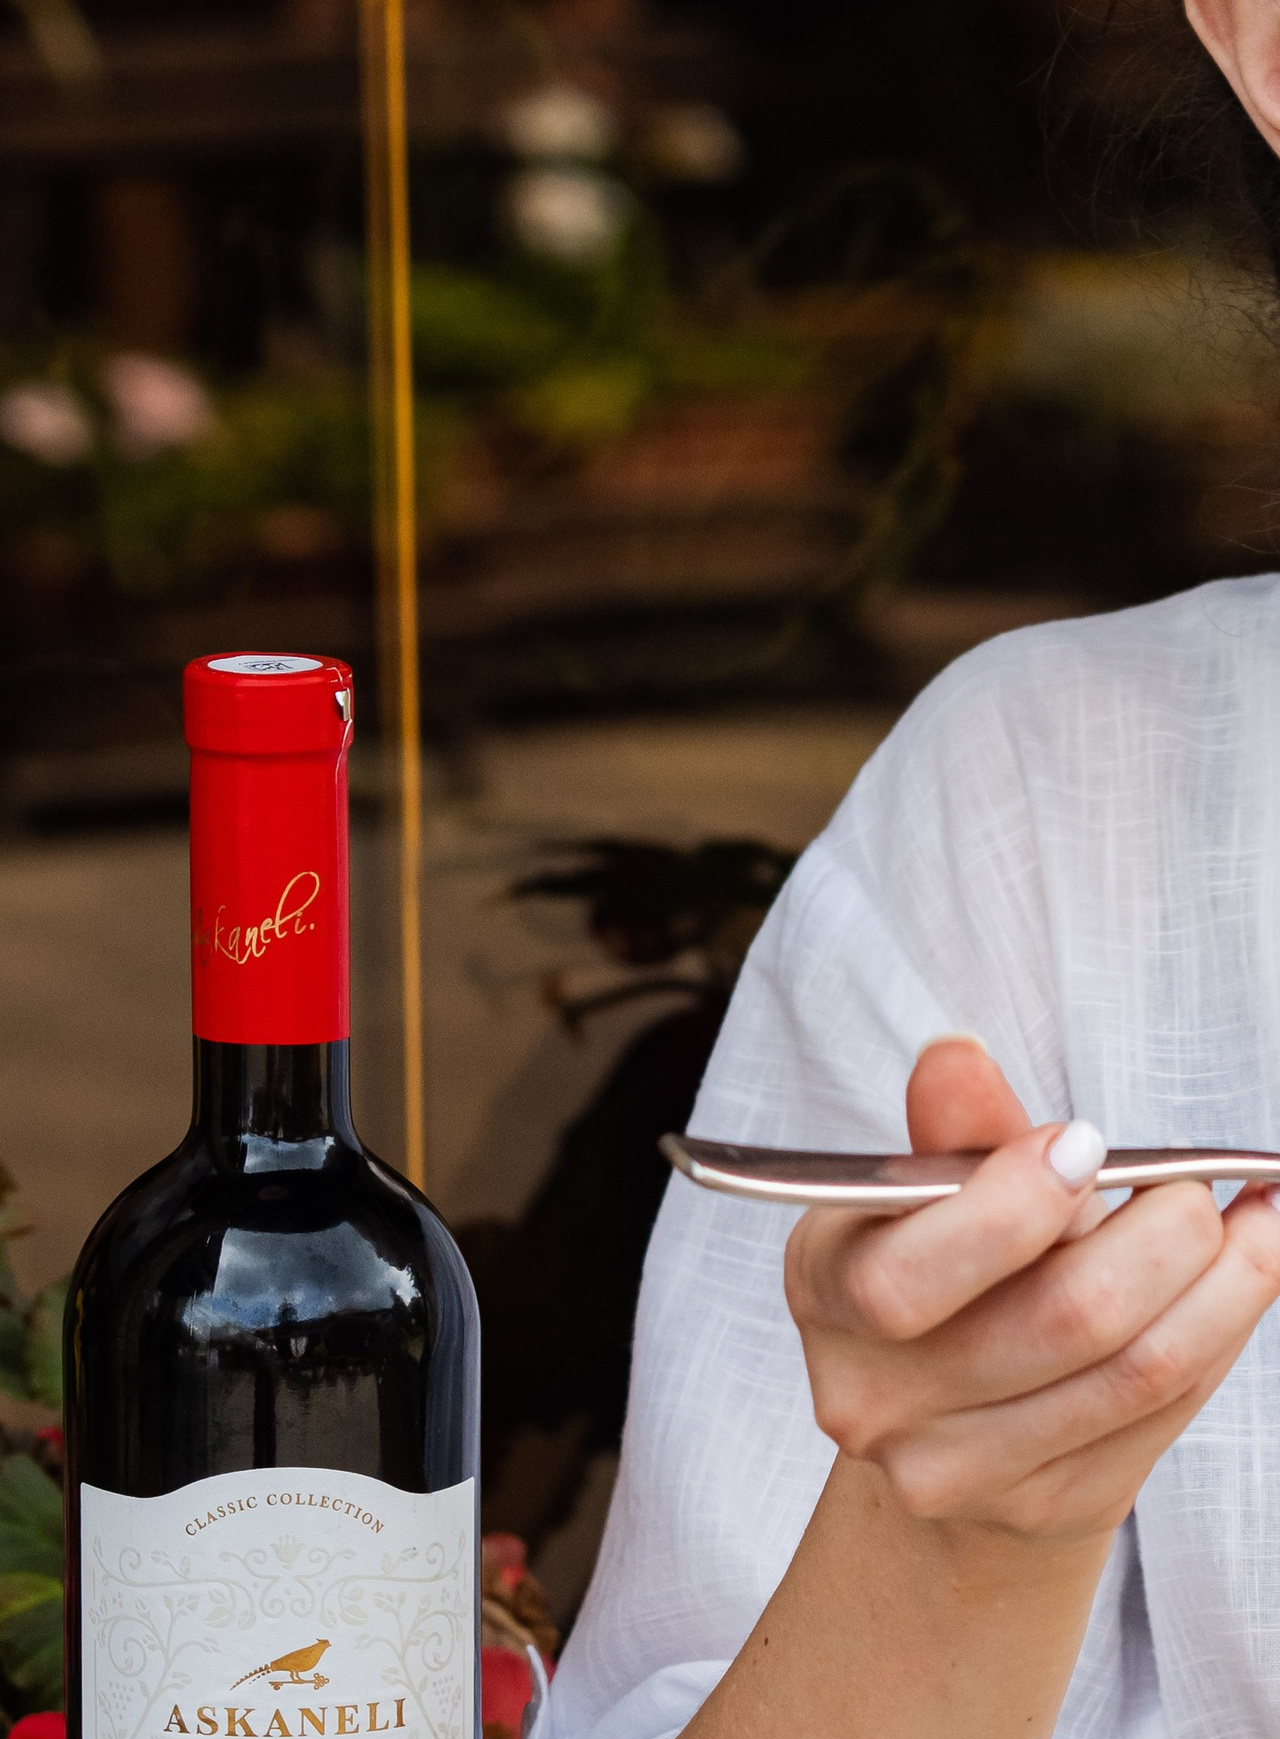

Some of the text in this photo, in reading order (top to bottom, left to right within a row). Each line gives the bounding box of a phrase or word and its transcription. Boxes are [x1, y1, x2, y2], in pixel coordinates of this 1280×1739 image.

[185, 1493, 385, 1536] CLASSIC COLLECTION
[164, 1697, 406, 1738] ASKANELI
